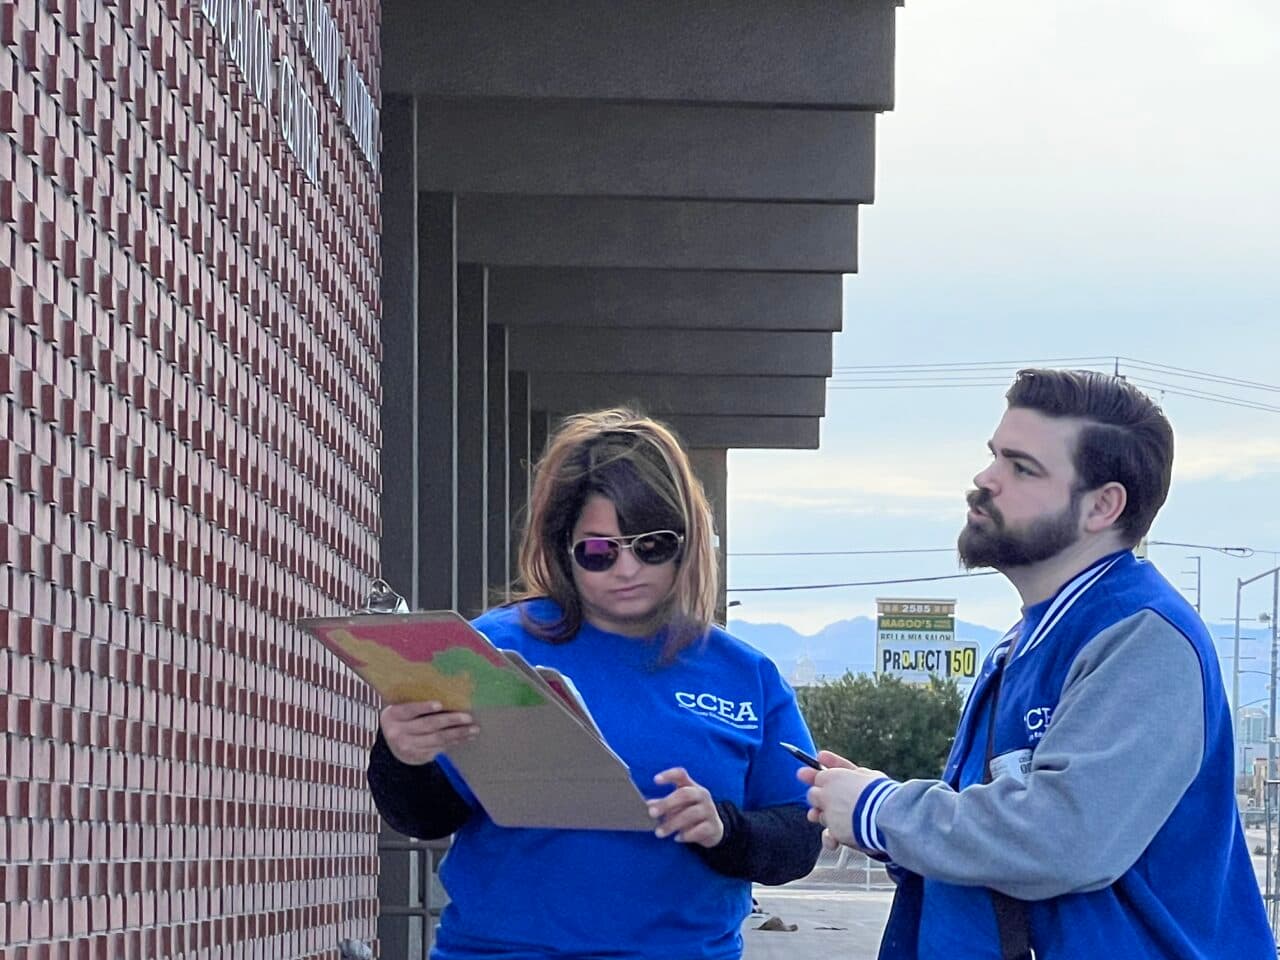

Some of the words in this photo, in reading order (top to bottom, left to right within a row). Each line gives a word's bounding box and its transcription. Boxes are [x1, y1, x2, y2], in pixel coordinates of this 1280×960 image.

[883, 649, 942, 672] PROJECT
[945, 647, 976, 677] 150
[675, 691, 759, 722] CCEA
